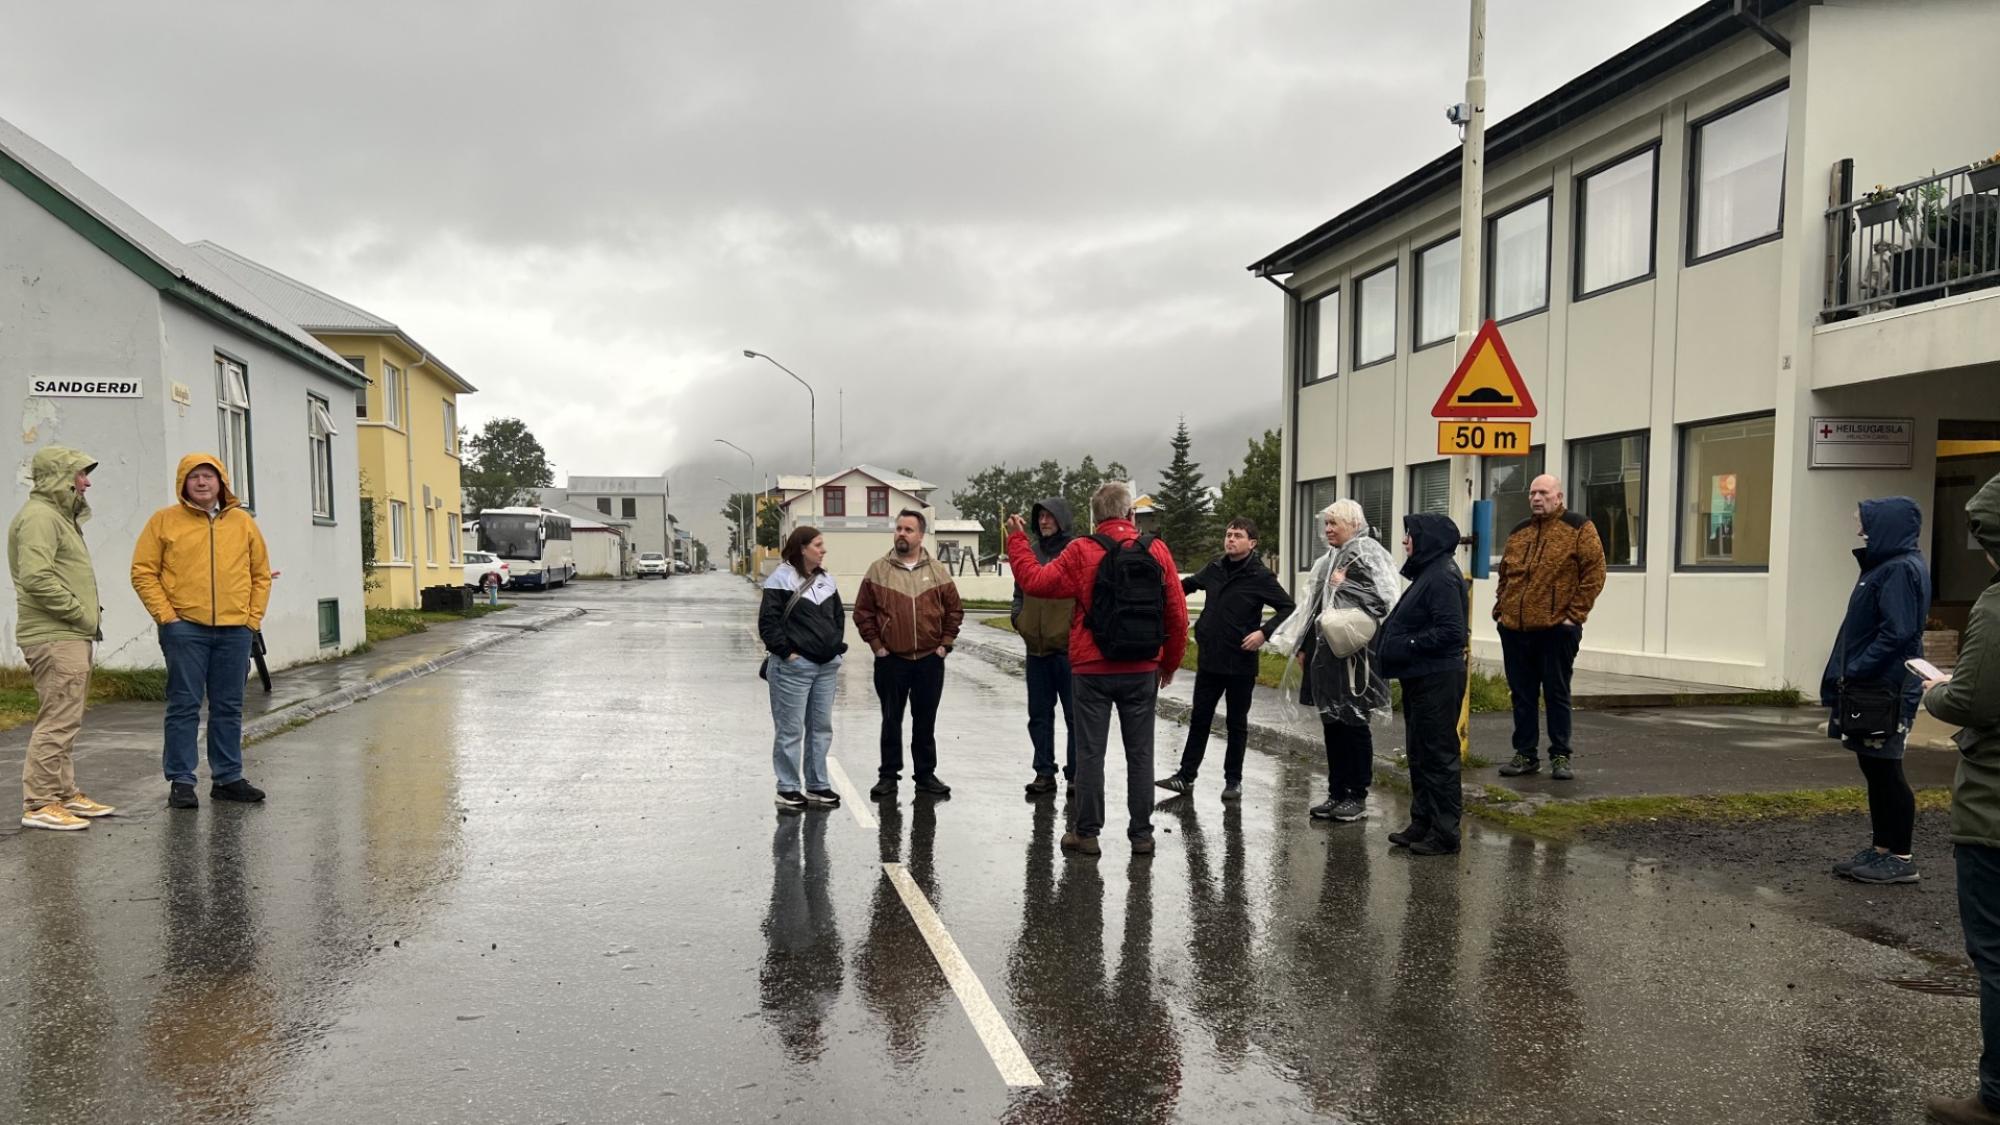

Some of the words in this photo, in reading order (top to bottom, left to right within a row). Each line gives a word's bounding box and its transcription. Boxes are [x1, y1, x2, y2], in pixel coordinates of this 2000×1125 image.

[34, 381, 138, 394] SANDGERÐI
[1836, 424, 1903, 434] HEILSUGÆSLA
[1455, 426, 1485, 449] 50
[1494, 431, 1517, 449] m
